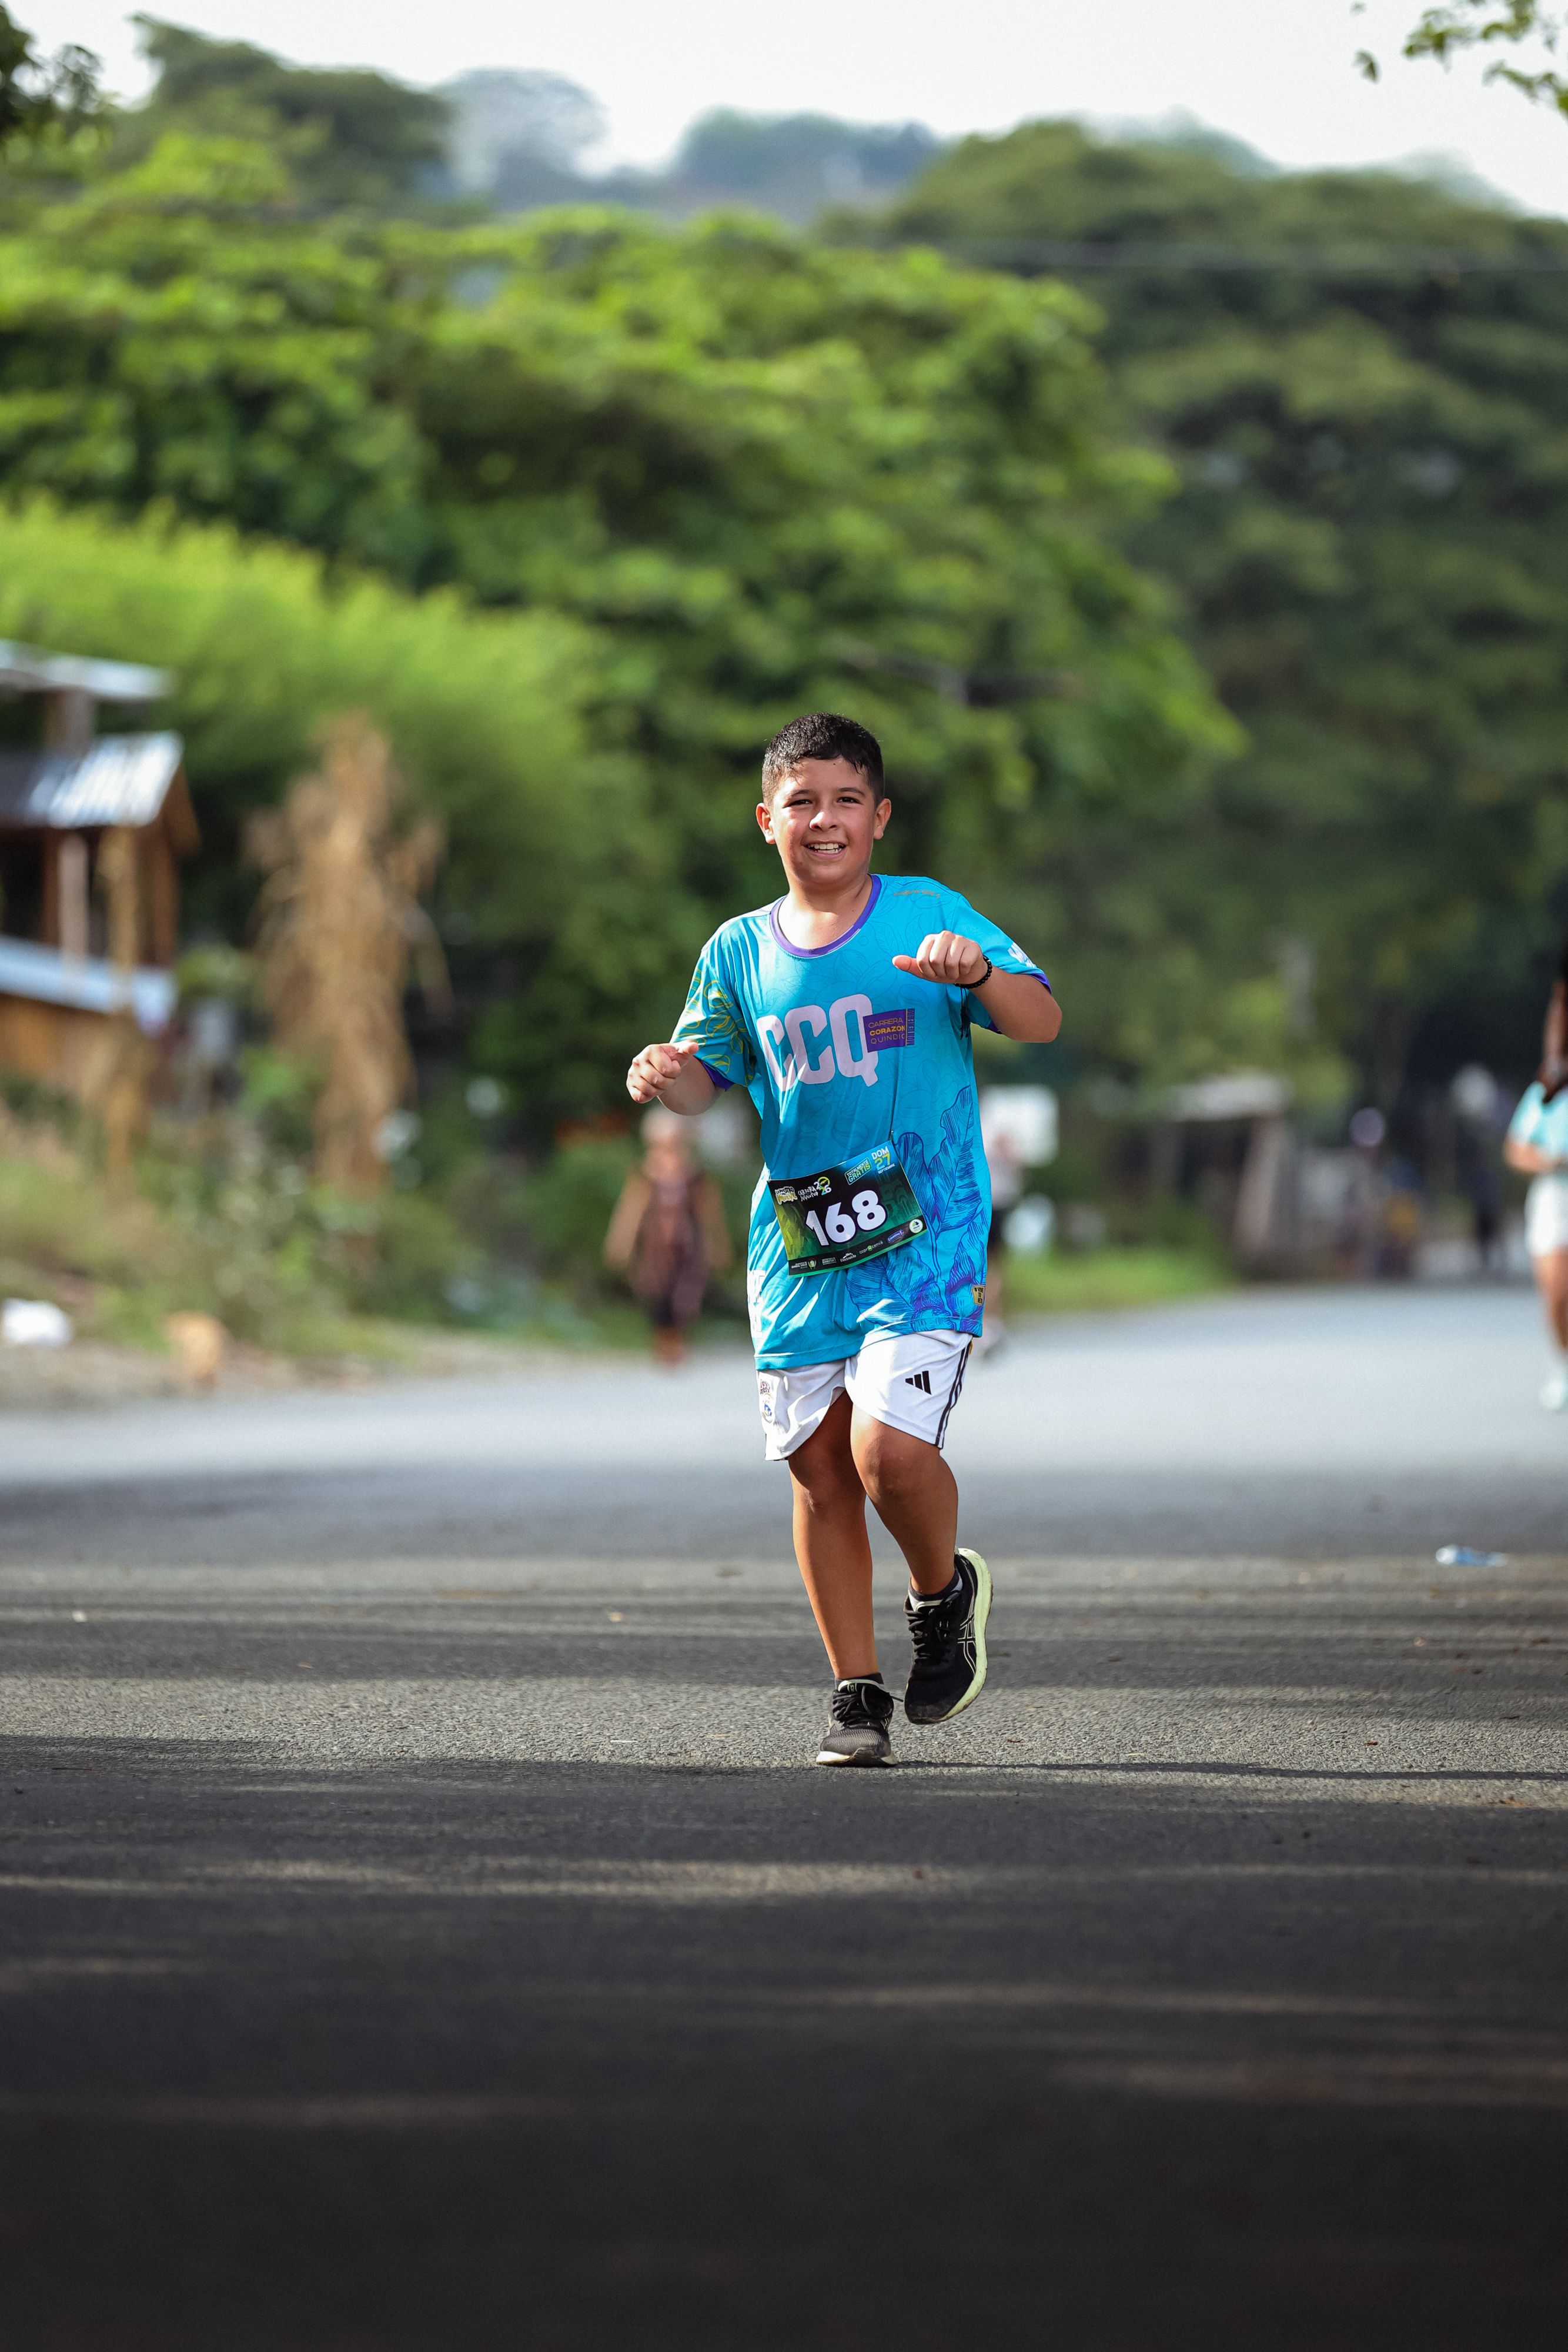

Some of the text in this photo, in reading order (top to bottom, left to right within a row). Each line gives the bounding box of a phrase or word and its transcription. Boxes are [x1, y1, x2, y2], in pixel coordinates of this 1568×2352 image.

[868, 1017, 904, 1028] CARRERA
[756, 993, 878, 1092] CCQ
[871, 1146, 890, 1160] DOM
[874, 1152, 891, 1171] 27
[847, 1159, 869, 1177] TOTALMENTE
[848, 1164, 870, 1182] GRATIS
[878, 1164, 895, 1174] SEPTIEMBRE
[798, 1186, 817, 1195] CARRERA
[805, 1190, 886, 1246] 168
